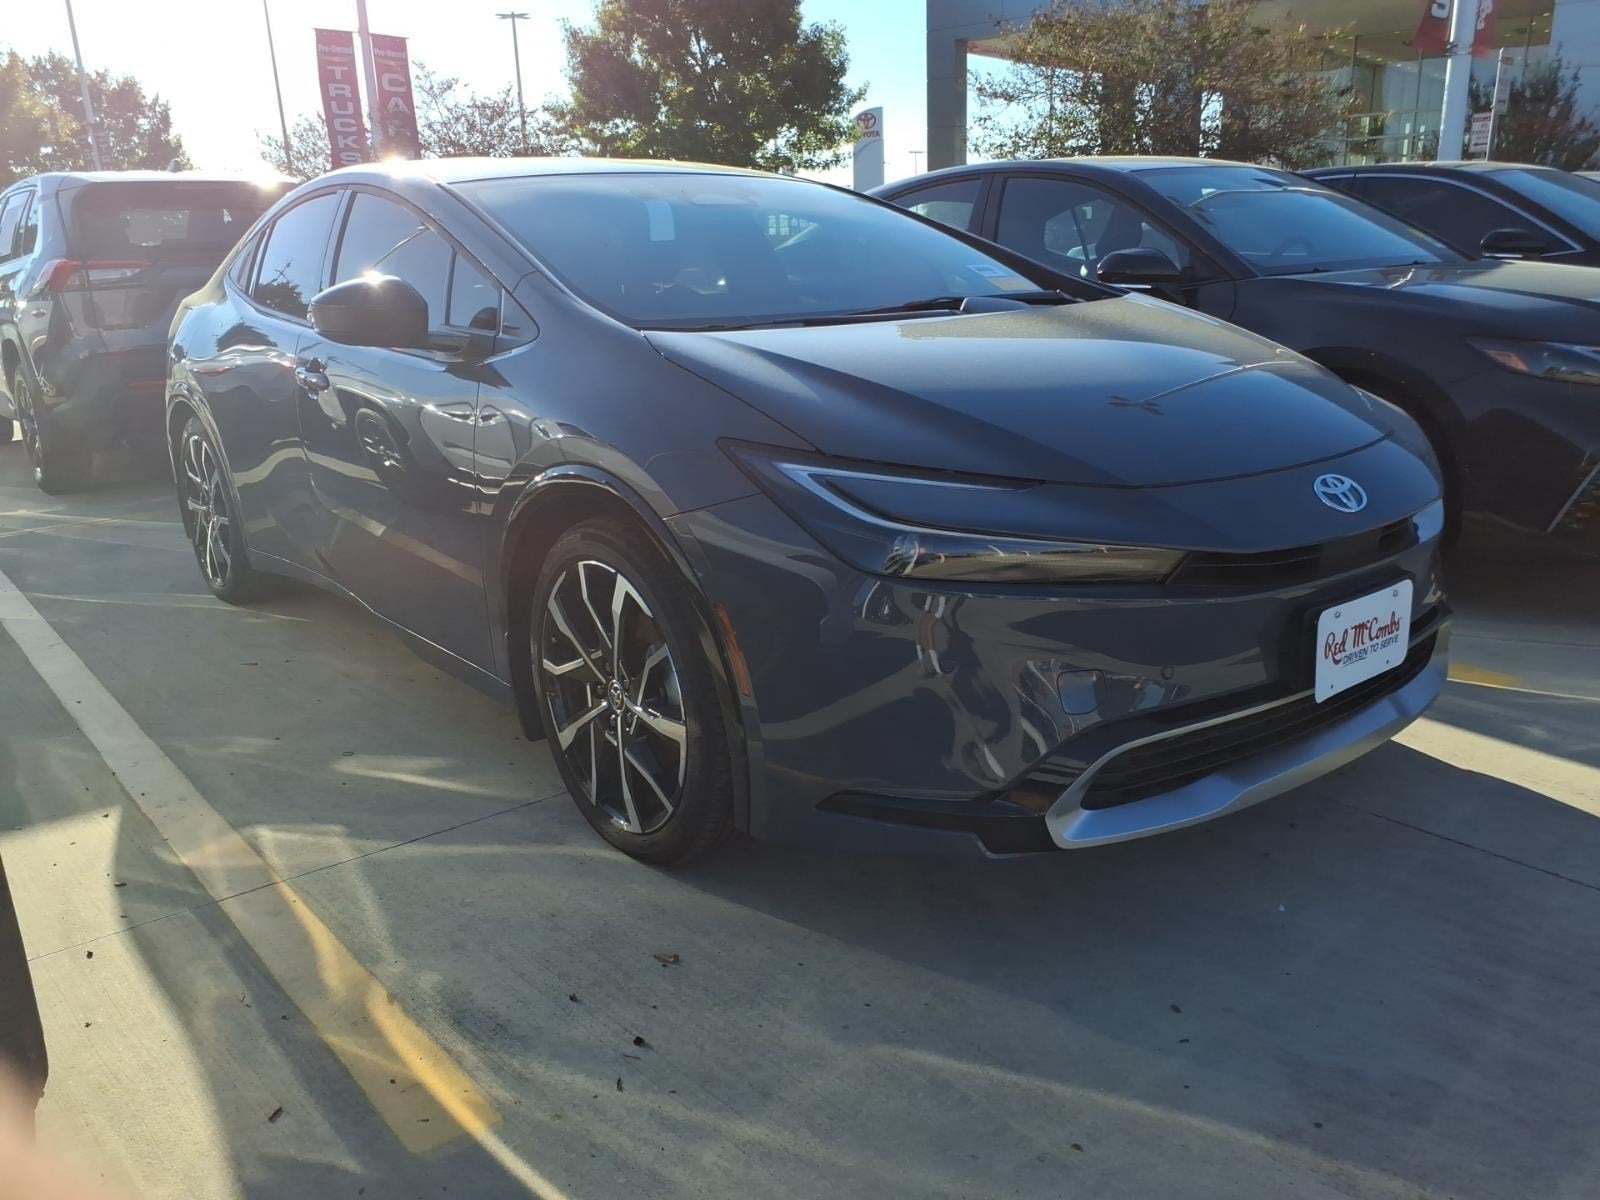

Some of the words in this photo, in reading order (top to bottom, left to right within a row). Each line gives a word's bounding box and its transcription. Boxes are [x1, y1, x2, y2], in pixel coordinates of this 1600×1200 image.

[327, 66, 362, 166] TRUCKS
[1324, 628, 1348, 665] Red
[1343, 647, 1369, 665] DRIVEN
[1370, 642, 1379, 653] TO
[1380, 634, 1399, 650] SERVE
